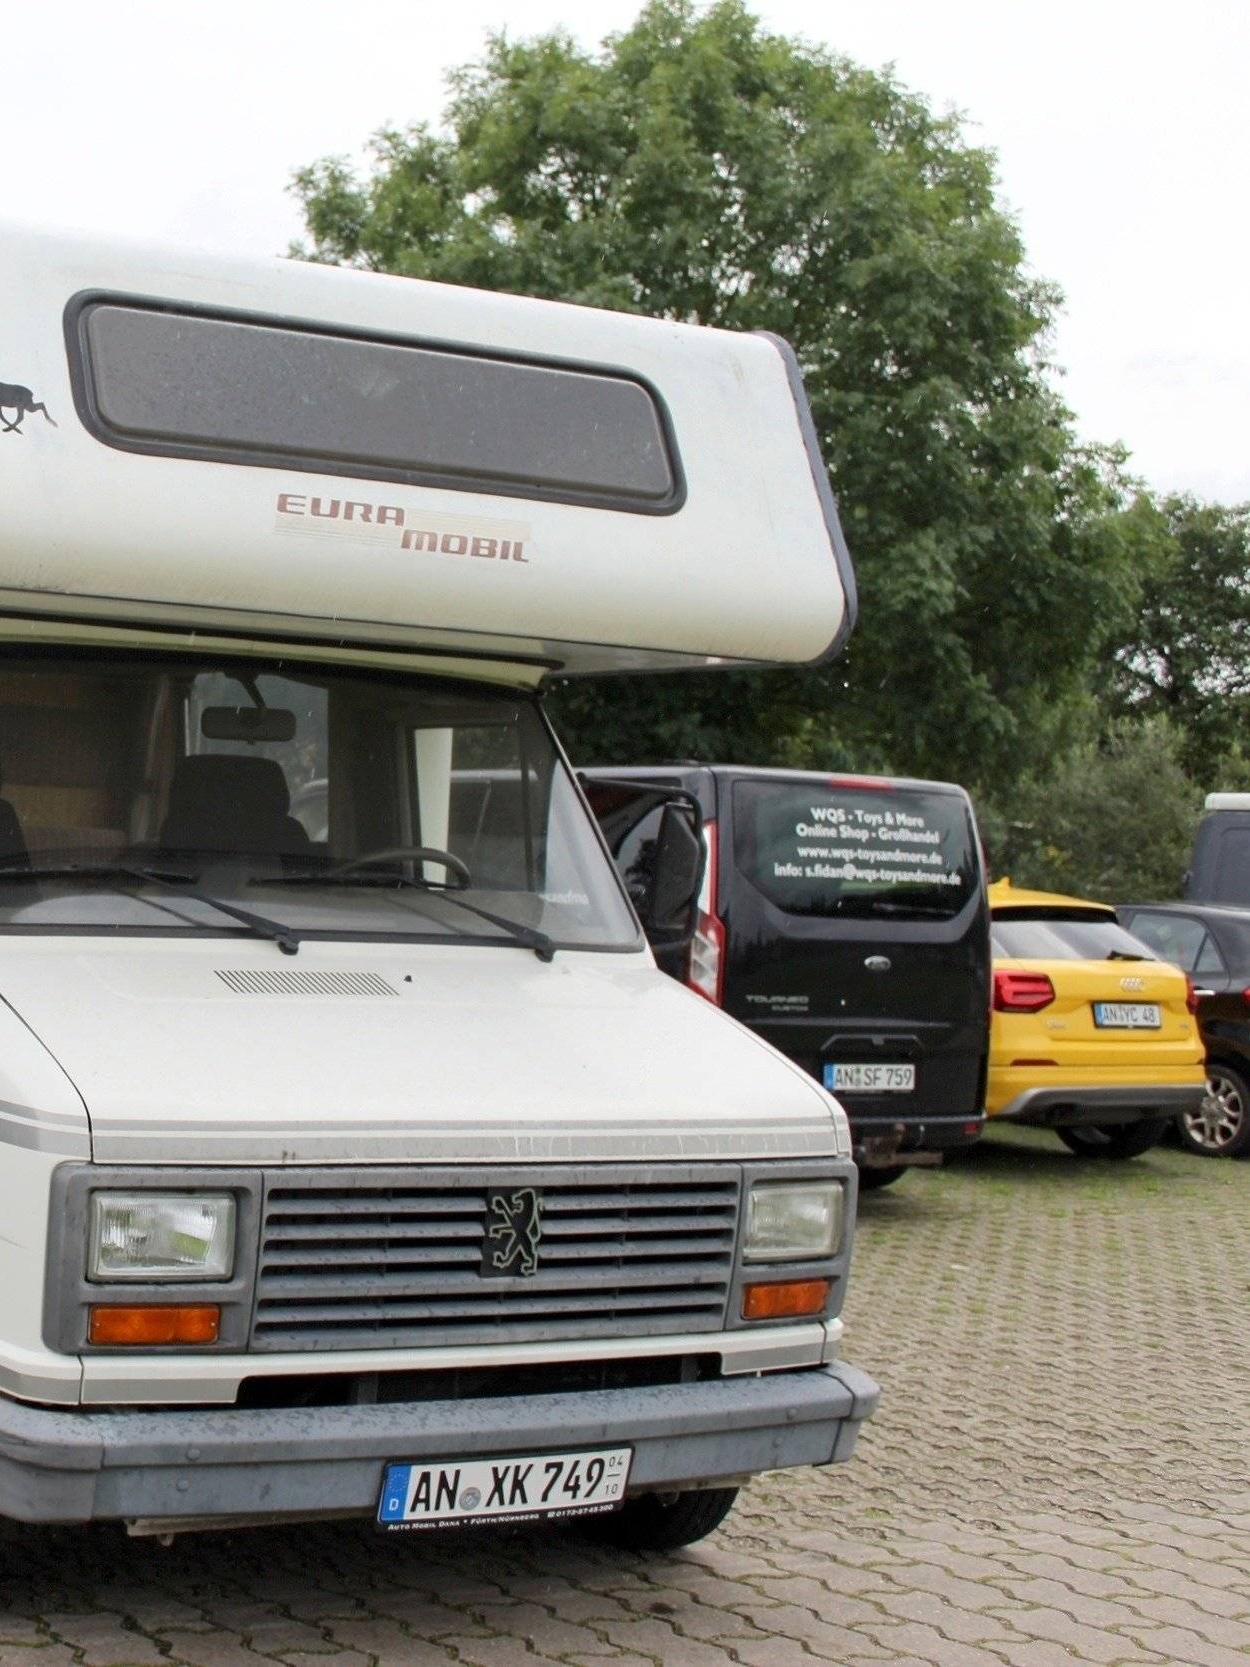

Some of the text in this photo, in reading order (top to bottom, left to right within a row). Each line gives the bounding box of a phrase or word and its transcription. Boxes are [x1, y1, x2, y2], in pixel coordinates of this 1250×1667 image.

[277, 493, 405, 527] EURA
[400, 529, 529, 563] MOBIL
[810, 807, 846, 824] WQS
[854, 809, 883, 827] Toys
[896, 812, 925, 828] More
[796, 823, 838, 838] Online
[839, 824, 870, 843] Shop
[1103, 1006, 1118, 1022] AN
[836, 1067, 912, 1087] AN SF 759
[608, 1456, 624, 1468] 04
[410, 1458, 606, 1513] AN XK 749
[605, 1483, 618, 1495] 10
[389, 1498, 399, 1511] D
